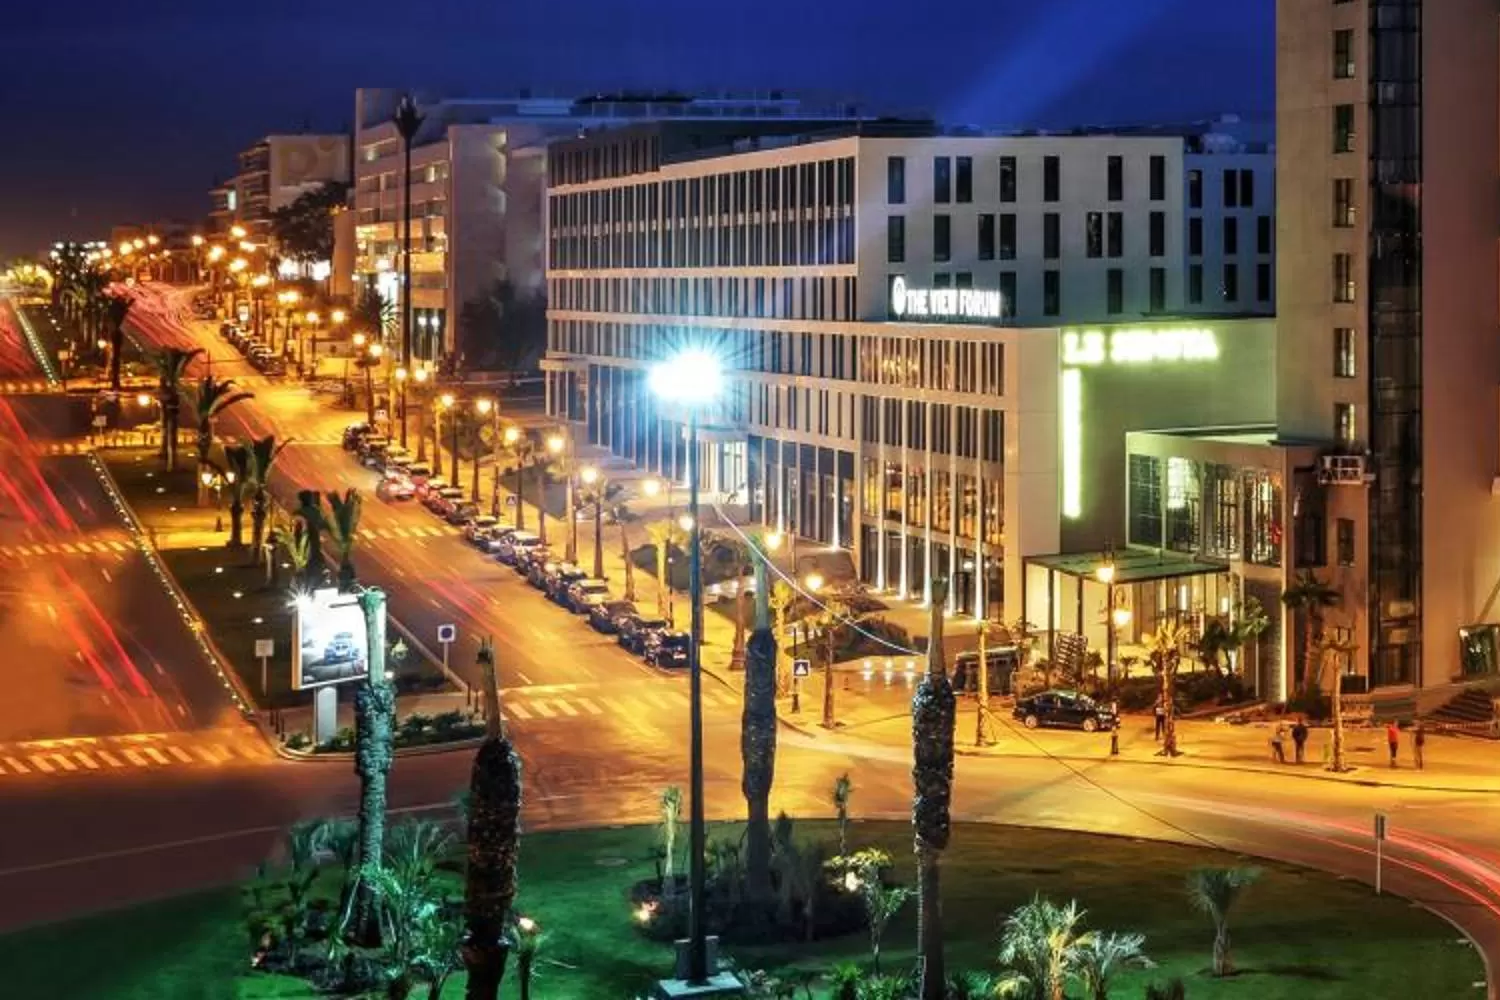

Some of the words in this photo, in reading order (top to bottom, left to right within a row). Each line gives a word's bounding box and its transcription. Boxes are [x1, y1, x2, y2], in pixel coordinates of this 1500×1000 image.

[906, 289, 929, 315] THE
[929, 289, 958, 316] VIEW
[959, 289, 1001, 318] FORUM
